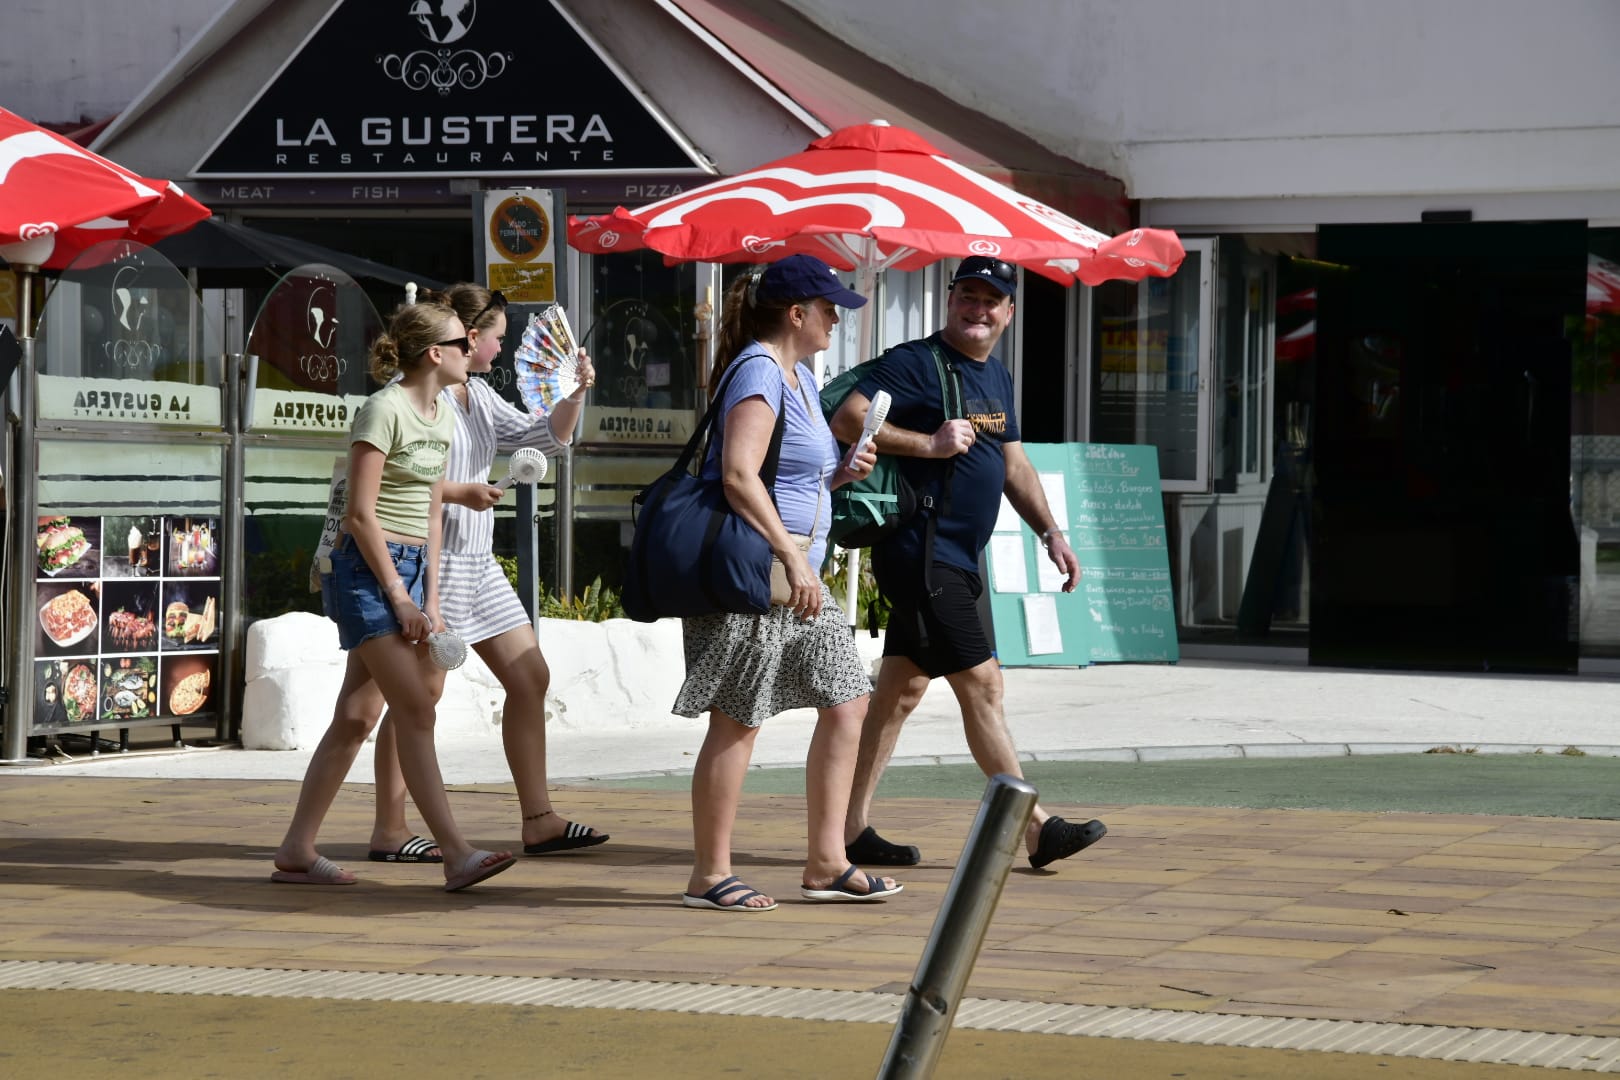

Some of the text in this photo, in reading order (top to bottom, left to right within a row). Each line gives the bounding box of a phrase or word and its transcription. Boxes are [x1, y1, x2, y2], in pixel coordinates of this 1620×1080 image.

[276, 114, 614, 146] LA GUSTERA
[276, 150, 614, 165] RESTAURANTE
[220, 184, 684, 199] MEAT FISH PIZZA
